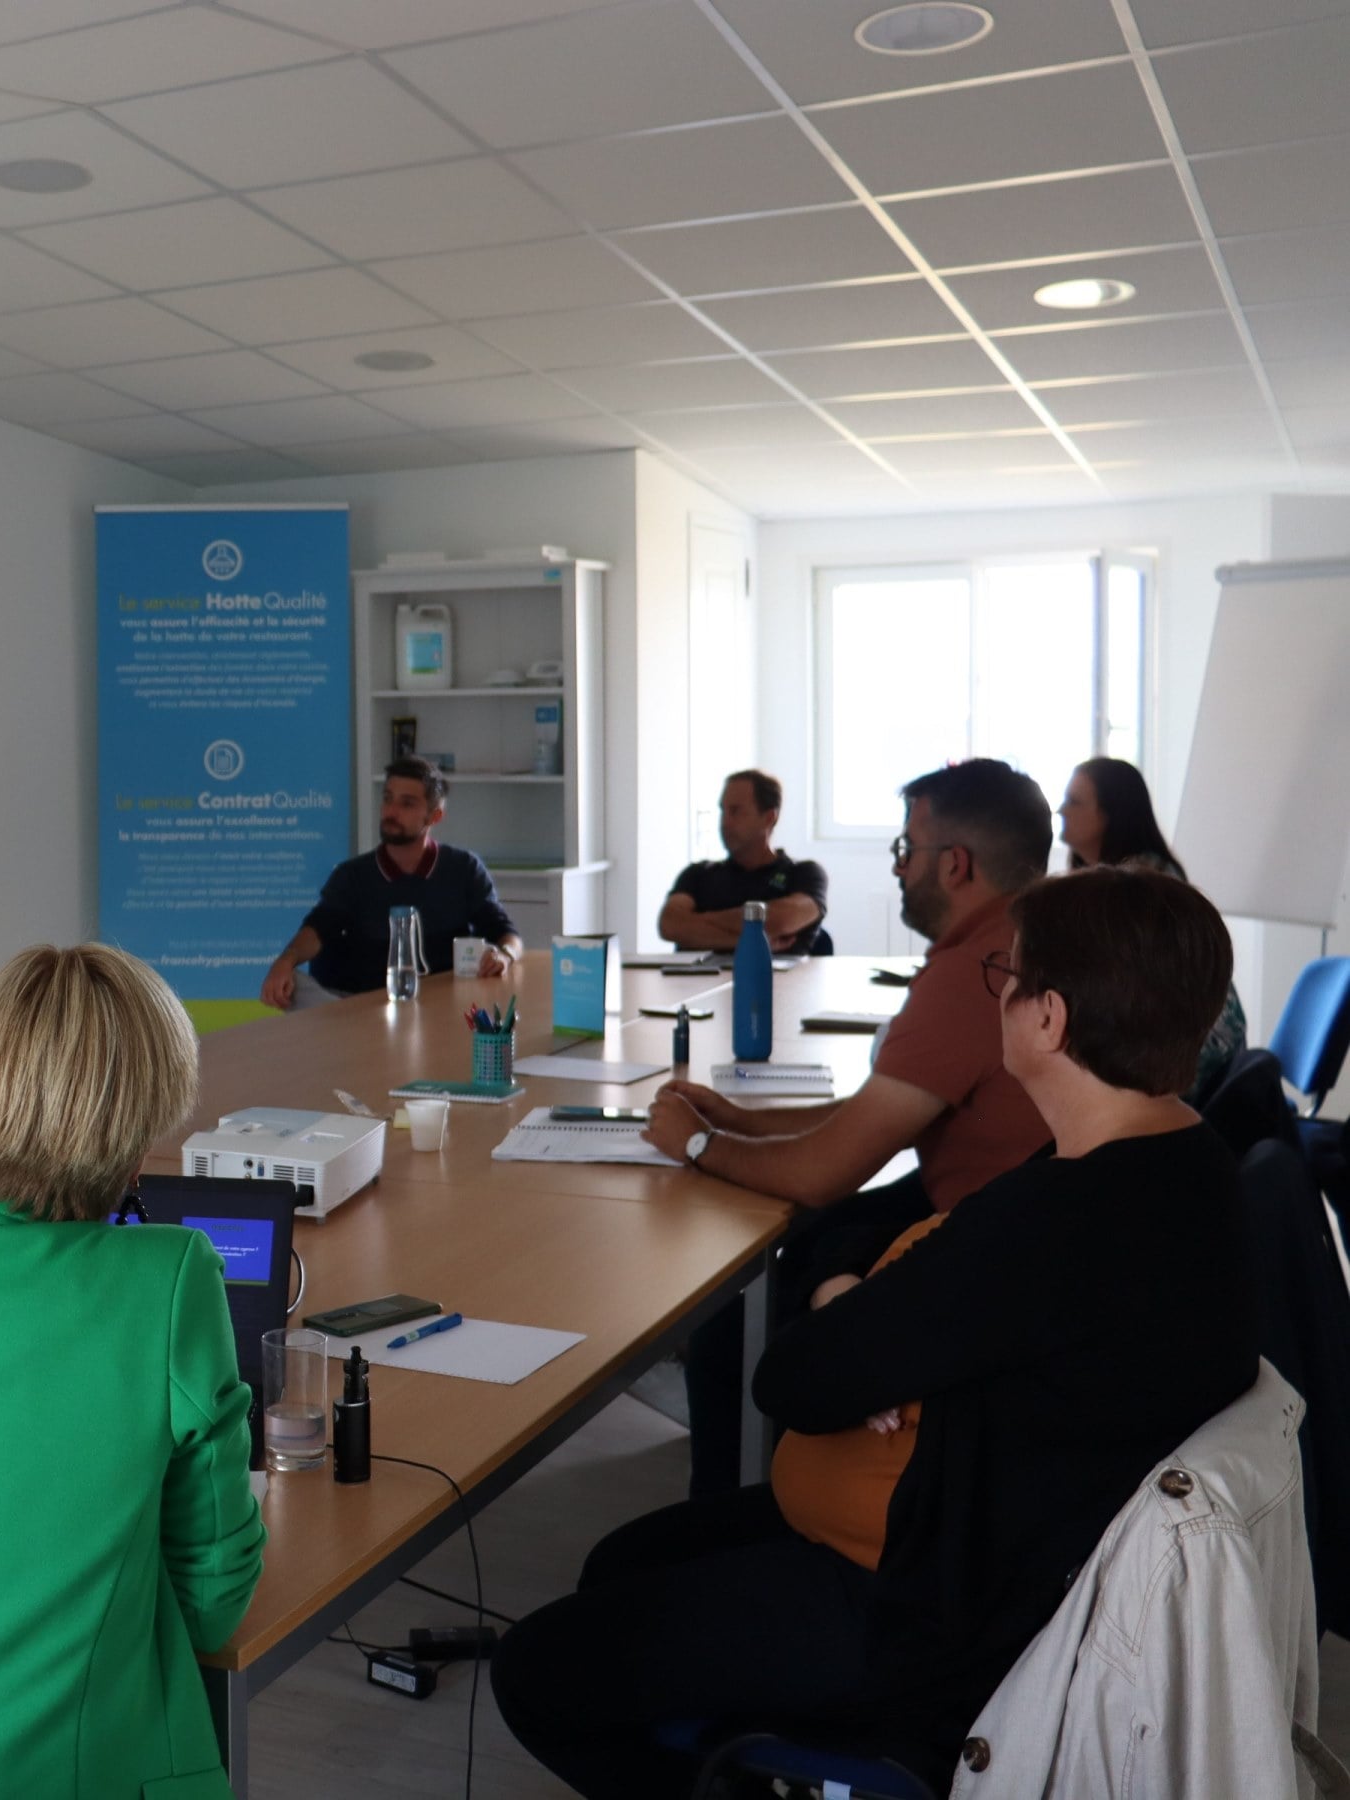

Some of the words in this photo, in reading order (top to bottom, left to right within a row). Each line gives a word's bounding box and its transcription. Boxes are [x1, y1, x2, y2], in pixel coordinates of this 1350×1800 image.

[119, 592, 139, 610] Le
[121, 618, 147, 627] vous
[150, 618, 188, 627] assure
[252, 617, 265, 627] et
[133, 630, 148, 642] de
[198, 630, 212, 642] de
[145, 817, 172, 827] vous
[175, 817, 213, 827] assure
[286, 815, 298, 827] et
